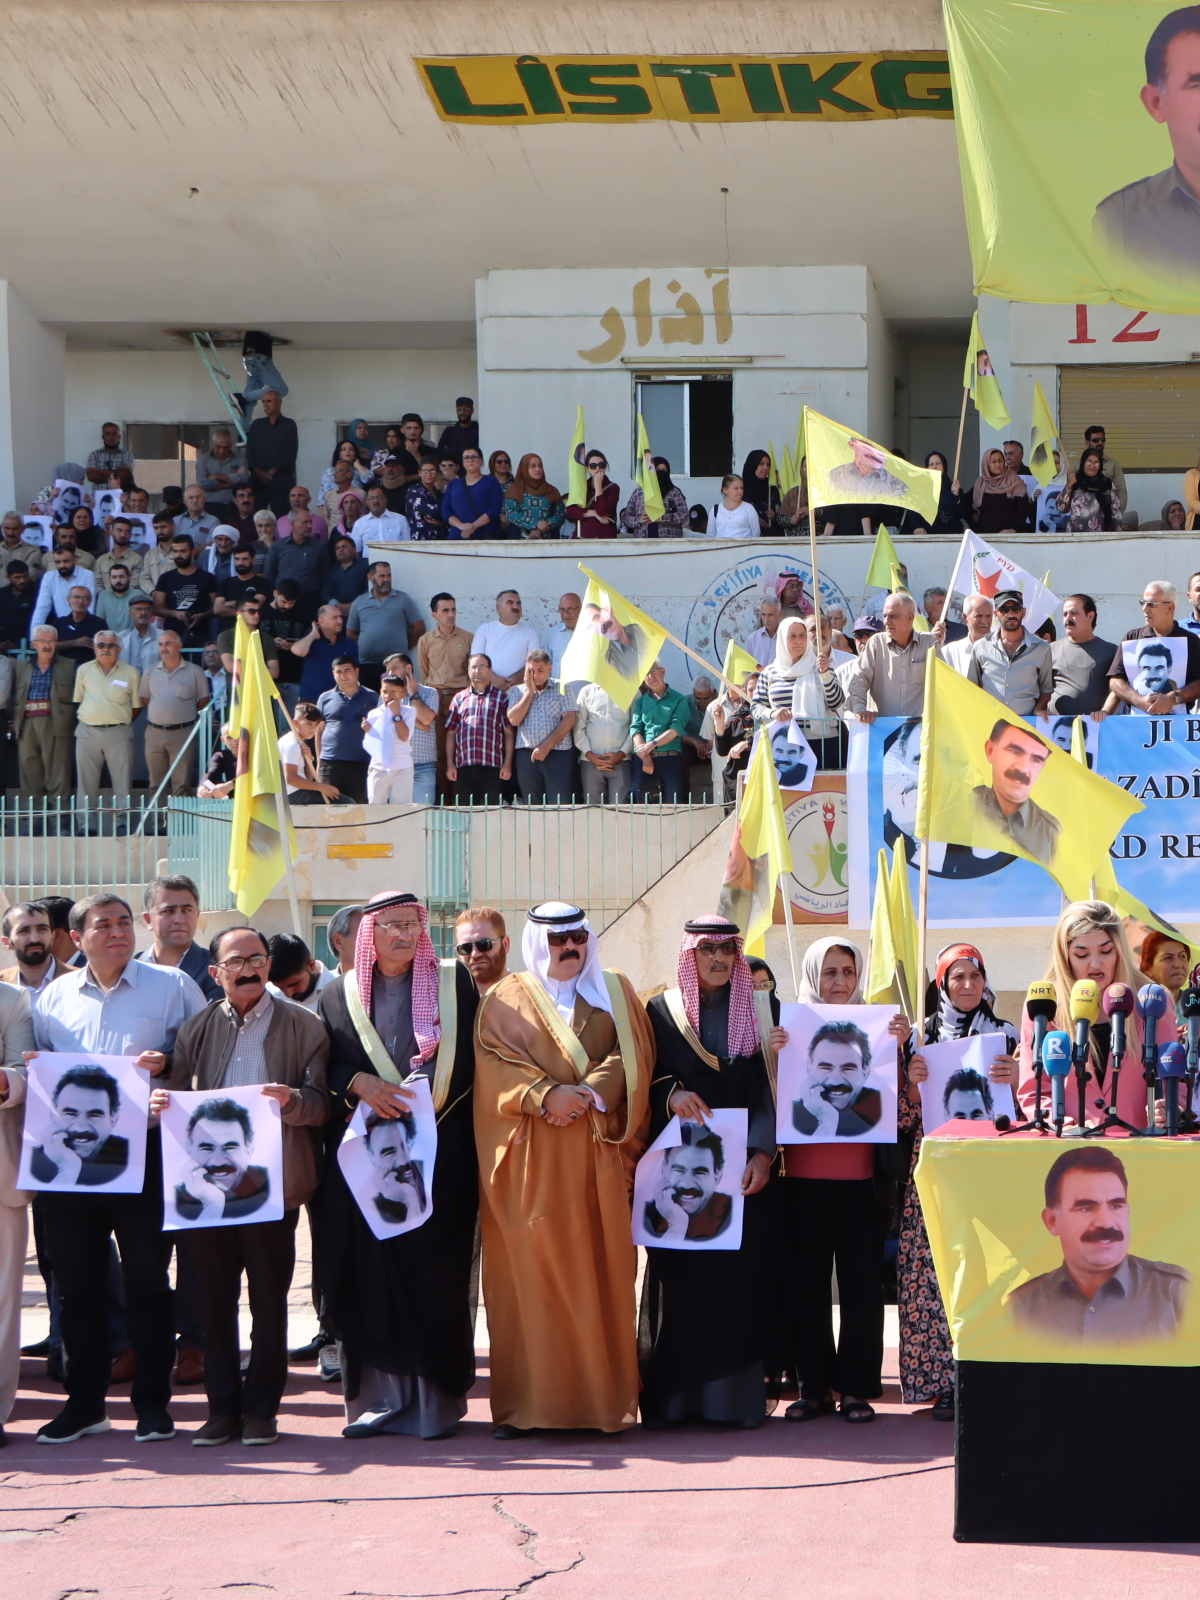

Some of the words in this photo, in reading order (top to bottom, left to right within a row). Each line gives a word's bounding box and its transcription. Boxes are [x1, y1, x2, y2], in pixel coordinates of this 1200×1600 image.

[577, 268, 734, 364] آذار
[997, 557, 1015, 572] PYD
[1144, 719, 1173, 748] JI
[1047, 1037, 1064, 1054] R
